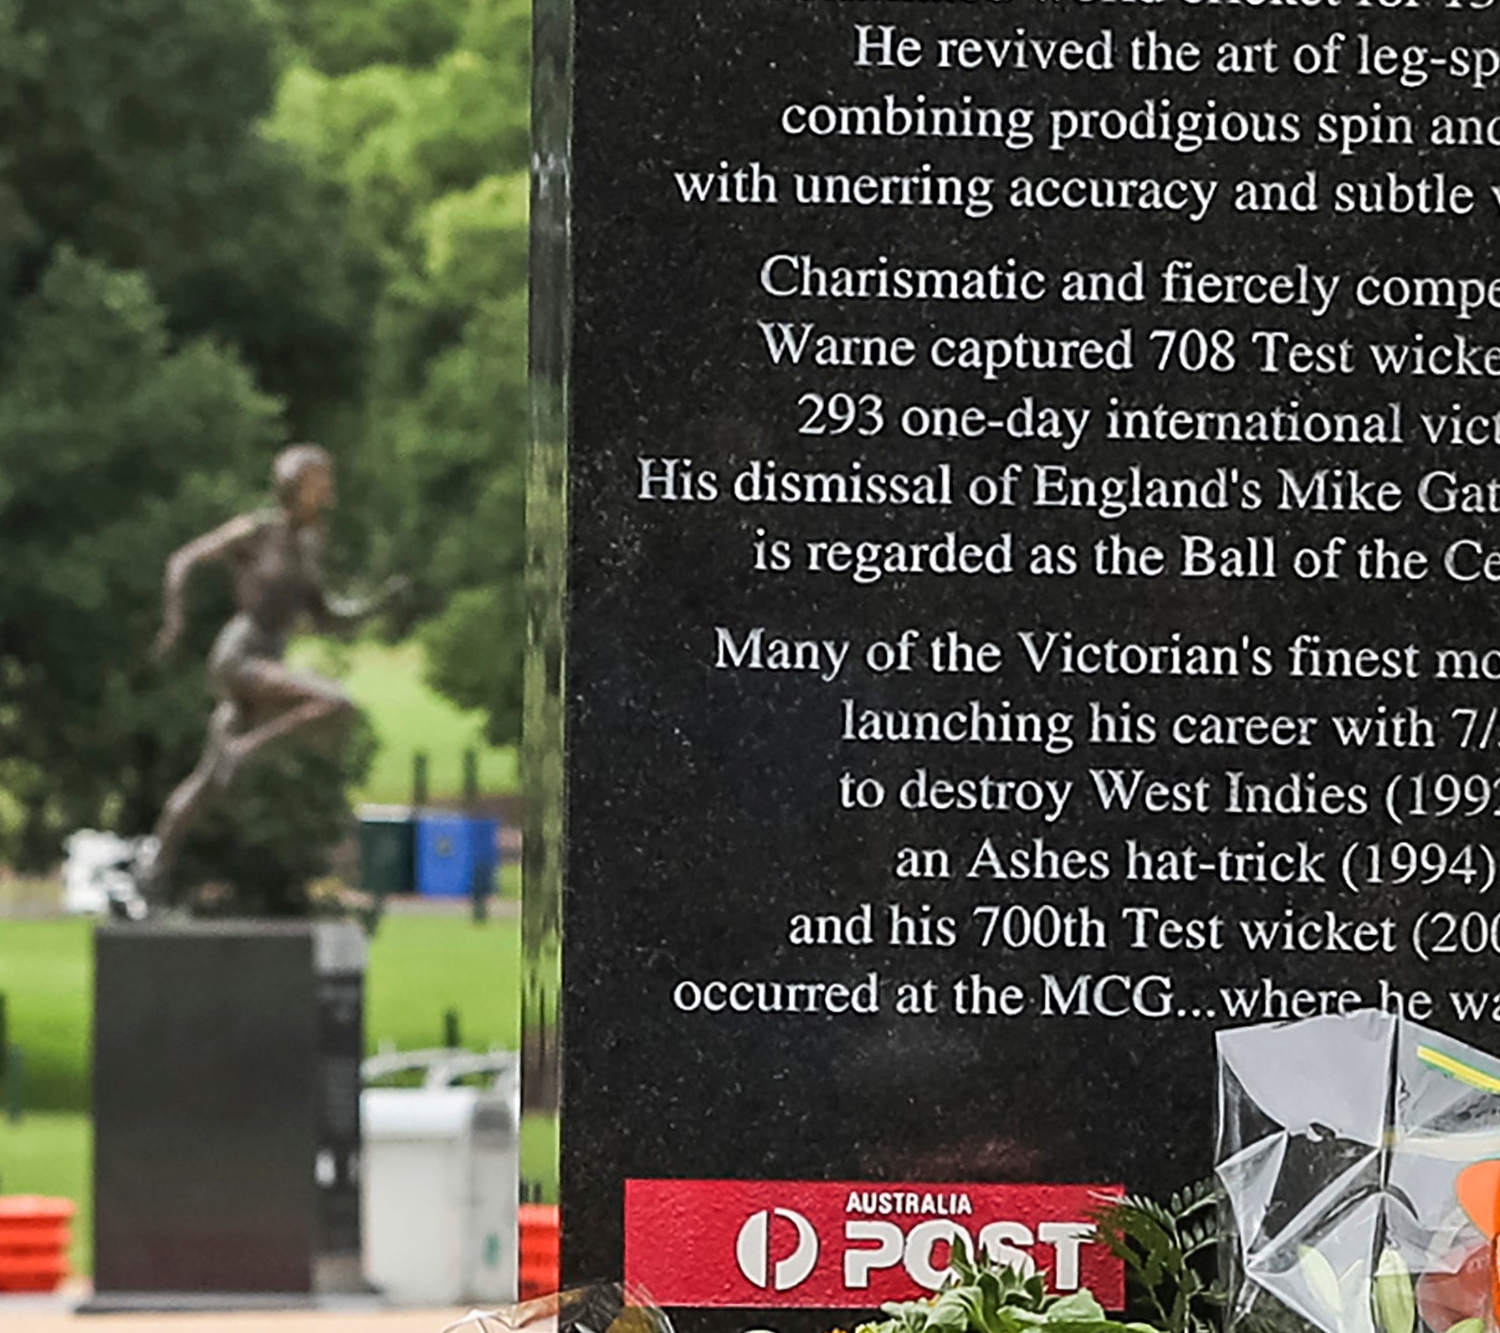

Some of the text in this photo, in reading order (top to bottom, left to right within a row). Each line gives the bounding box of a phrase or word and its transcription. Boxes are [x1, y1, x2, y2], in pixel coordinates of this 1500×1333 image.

[853, 23, 923, 68] He
[937, 27, 1115, 71] revived
[1130, 29, 1201, 72] the
[1216, 37, 1279, 74] art
[1293, 31, 1347, 75] of
[781, 93, 1035, 150] combining
[1048, 98, 1301, 153] prodigious
[1317, 101, 1414, 156] spin
[673, 160, 779, 204] with
[793, 163, 995, 219] unerring
[1009, 176, 1219, 222] accuracy
[1234, 170, 1319, 212] and
[1334, 171, 1475, 215] subtle
[760, 254, 1046, 301] Charismatic
[1061, 260, 1146, 302] and
[1161, 259, 1341, 317] fiercely
[756, 318, 916, 367] Warne
[930, 328, 1134, 381] captured
[1149, 327, 1236, 372] 708
[1251, 330, 1355, 374] Test
[797, 392, 885, 436] 293
[901, 396, 1091, 451] one-day
[1106, 396, 1404, 444] international
[637, 456, 719, 501] His
[733, 459, 953, 505] dismissal
[968, 462, 1023, 506] of
[1032, 463, 1263, 520] England's
[1276, 467, 1403, 513] Mike
[753, 527, 792, 571] is
[806, 531, 1014, 584] regarded
[1029, 543, 1078, 575] as
[1093, 533, 1165, 577] the
[1180, 534, 1277, 578] Ball
[1293, 535, 1347, 579] of
[1357, 537, 1429, 580] the
[714, 626, 850, 683] Many
[866, 628, 920, 672] of
[930, 630, 1002, 674] the
[1016, 630, 1273, 677] Victorian's
[1287, 634, 1421, 679] finest
[841, 698, 1074, 755] launching
[1088, 701, 1157, 744] his
[1172, 713, 1319, 746] career
[1331, 705, 1436, 748] with
[839, 771, 886, 809] to
[899, 768, 1074, 823] destroy
[1088, 768, 1211, 813] West
[1224, 770, 1369, 815] Indies
[895, 836, 1497, 894] an Ashes hat-trick (1994)
[788, 902, 874, 946] and
[888, 903, 957, 947] his
[972, 904, 1107, 949] 700th
[1121, 906, 1225, 950] Test
[1239, 908, 1398, 953] wicket
[673, 971, 880, 1014] occurred
[895, 979, 939, 1014] at
[953, 973, 1025, 1016] the
[1040, 973, 1362, 1018] MCG...where
[1378, 978, 1433, 1022] he
[846, 1191, 973, 1216] AUSTRALIA
[843, 1219, 1098, 1291] POST
